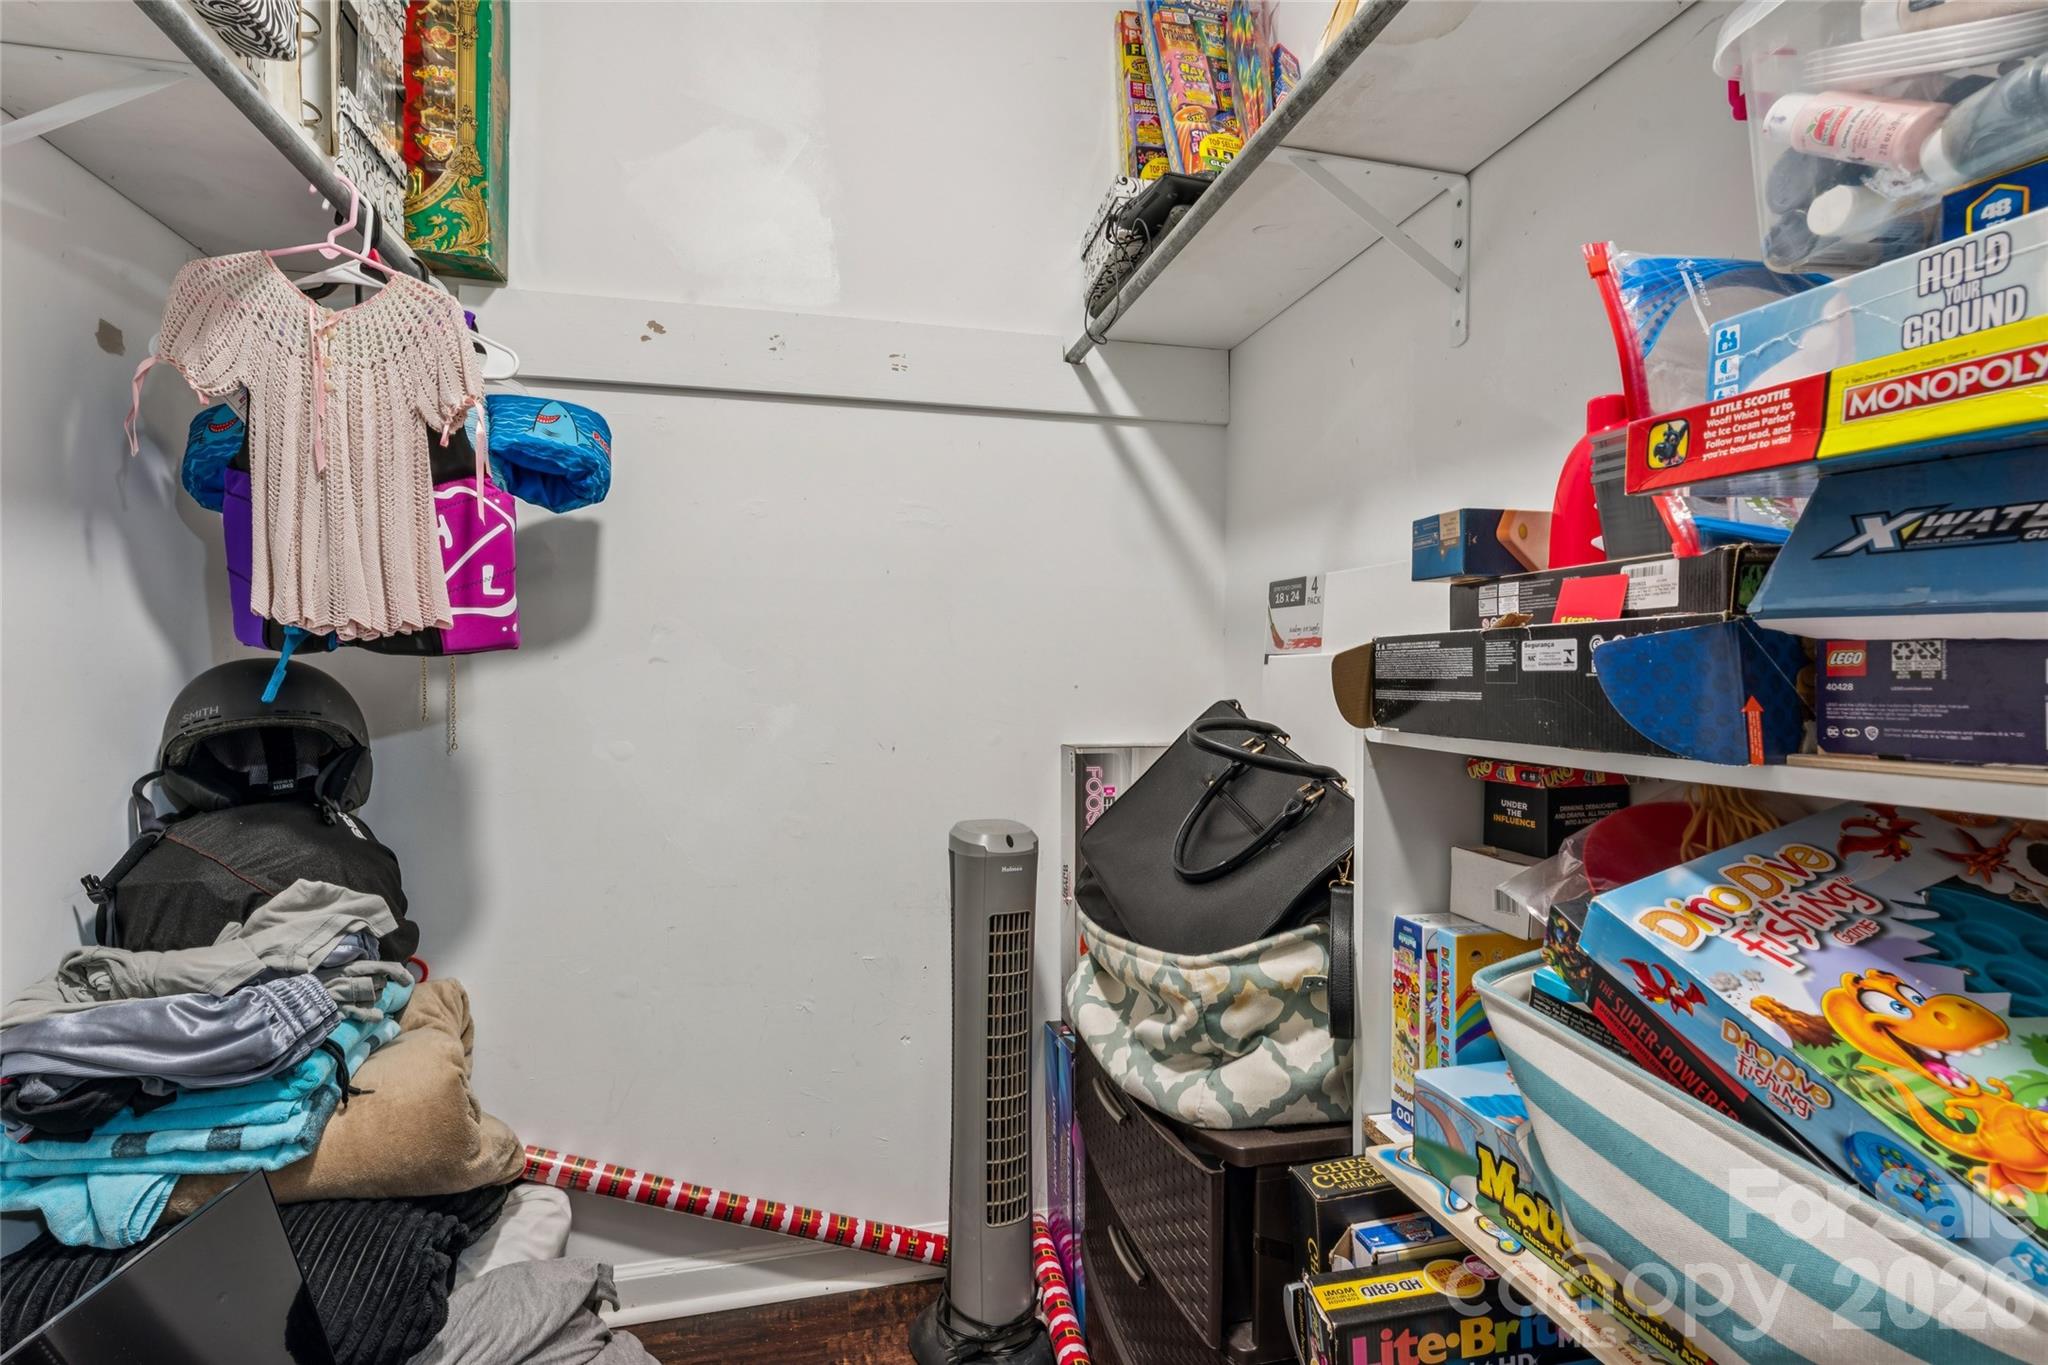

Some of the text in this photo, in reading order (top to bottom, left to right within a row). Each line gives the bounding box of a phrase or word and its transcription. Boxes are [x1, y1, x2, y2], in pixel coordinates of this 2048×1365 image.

[1980, 198, 2012, 220] 48
[1918, 231, 2011, 297] HOLD
[1945, 280, 1982, 305] YOUR
[1902, 285, 2027, 350] GROUND
[1848, 349, 2048, 417] MONOPOLY
[1709, 388, 1791, 416] LITTLE SCOTTIE
[1706, 402, 1793, 428] Woof! Which way to
[1703, 411, 1796, 439] the Ice Cream Parlor?
[1705, 424, 1791, 449] Follow my lead, and
[1702, 434, 1792, 462] you're bound to win!
[1311, 576, 1318, 594] 4
[1275, 593, 1284, 604] 18
[1290, 590, 1300, 602] 24
[1307, 596, 1321, 606] PACK
[1829, 651, 1864, 666] LEGO
[1826, 683, 1854, 691] 40428
[182, 706, 219, 723] SMITH
[1467, 761, 1494, 779] UNO
[1501, 799, 1528, 810] UNDER
[1507, 809, 1522, 818] THE
[1493, 814, 1536, 829] INFLUENCE
[1598, 978, 1614, 999] THE
[1312, 1166, 1382, 1189] CHEC
[1338, 1180, 1365, 1191] with
[1506, 1216, 1522, 1234] The
[1523, 1228, 1552, 1258] Classic
[1553, 1253, 1581, 1279] Game
[1582, 1274, 1595, 1290] Of
[1359, 1281, 1401, 1299] GRID
[1401, 1277, 1423, 1292] HD
